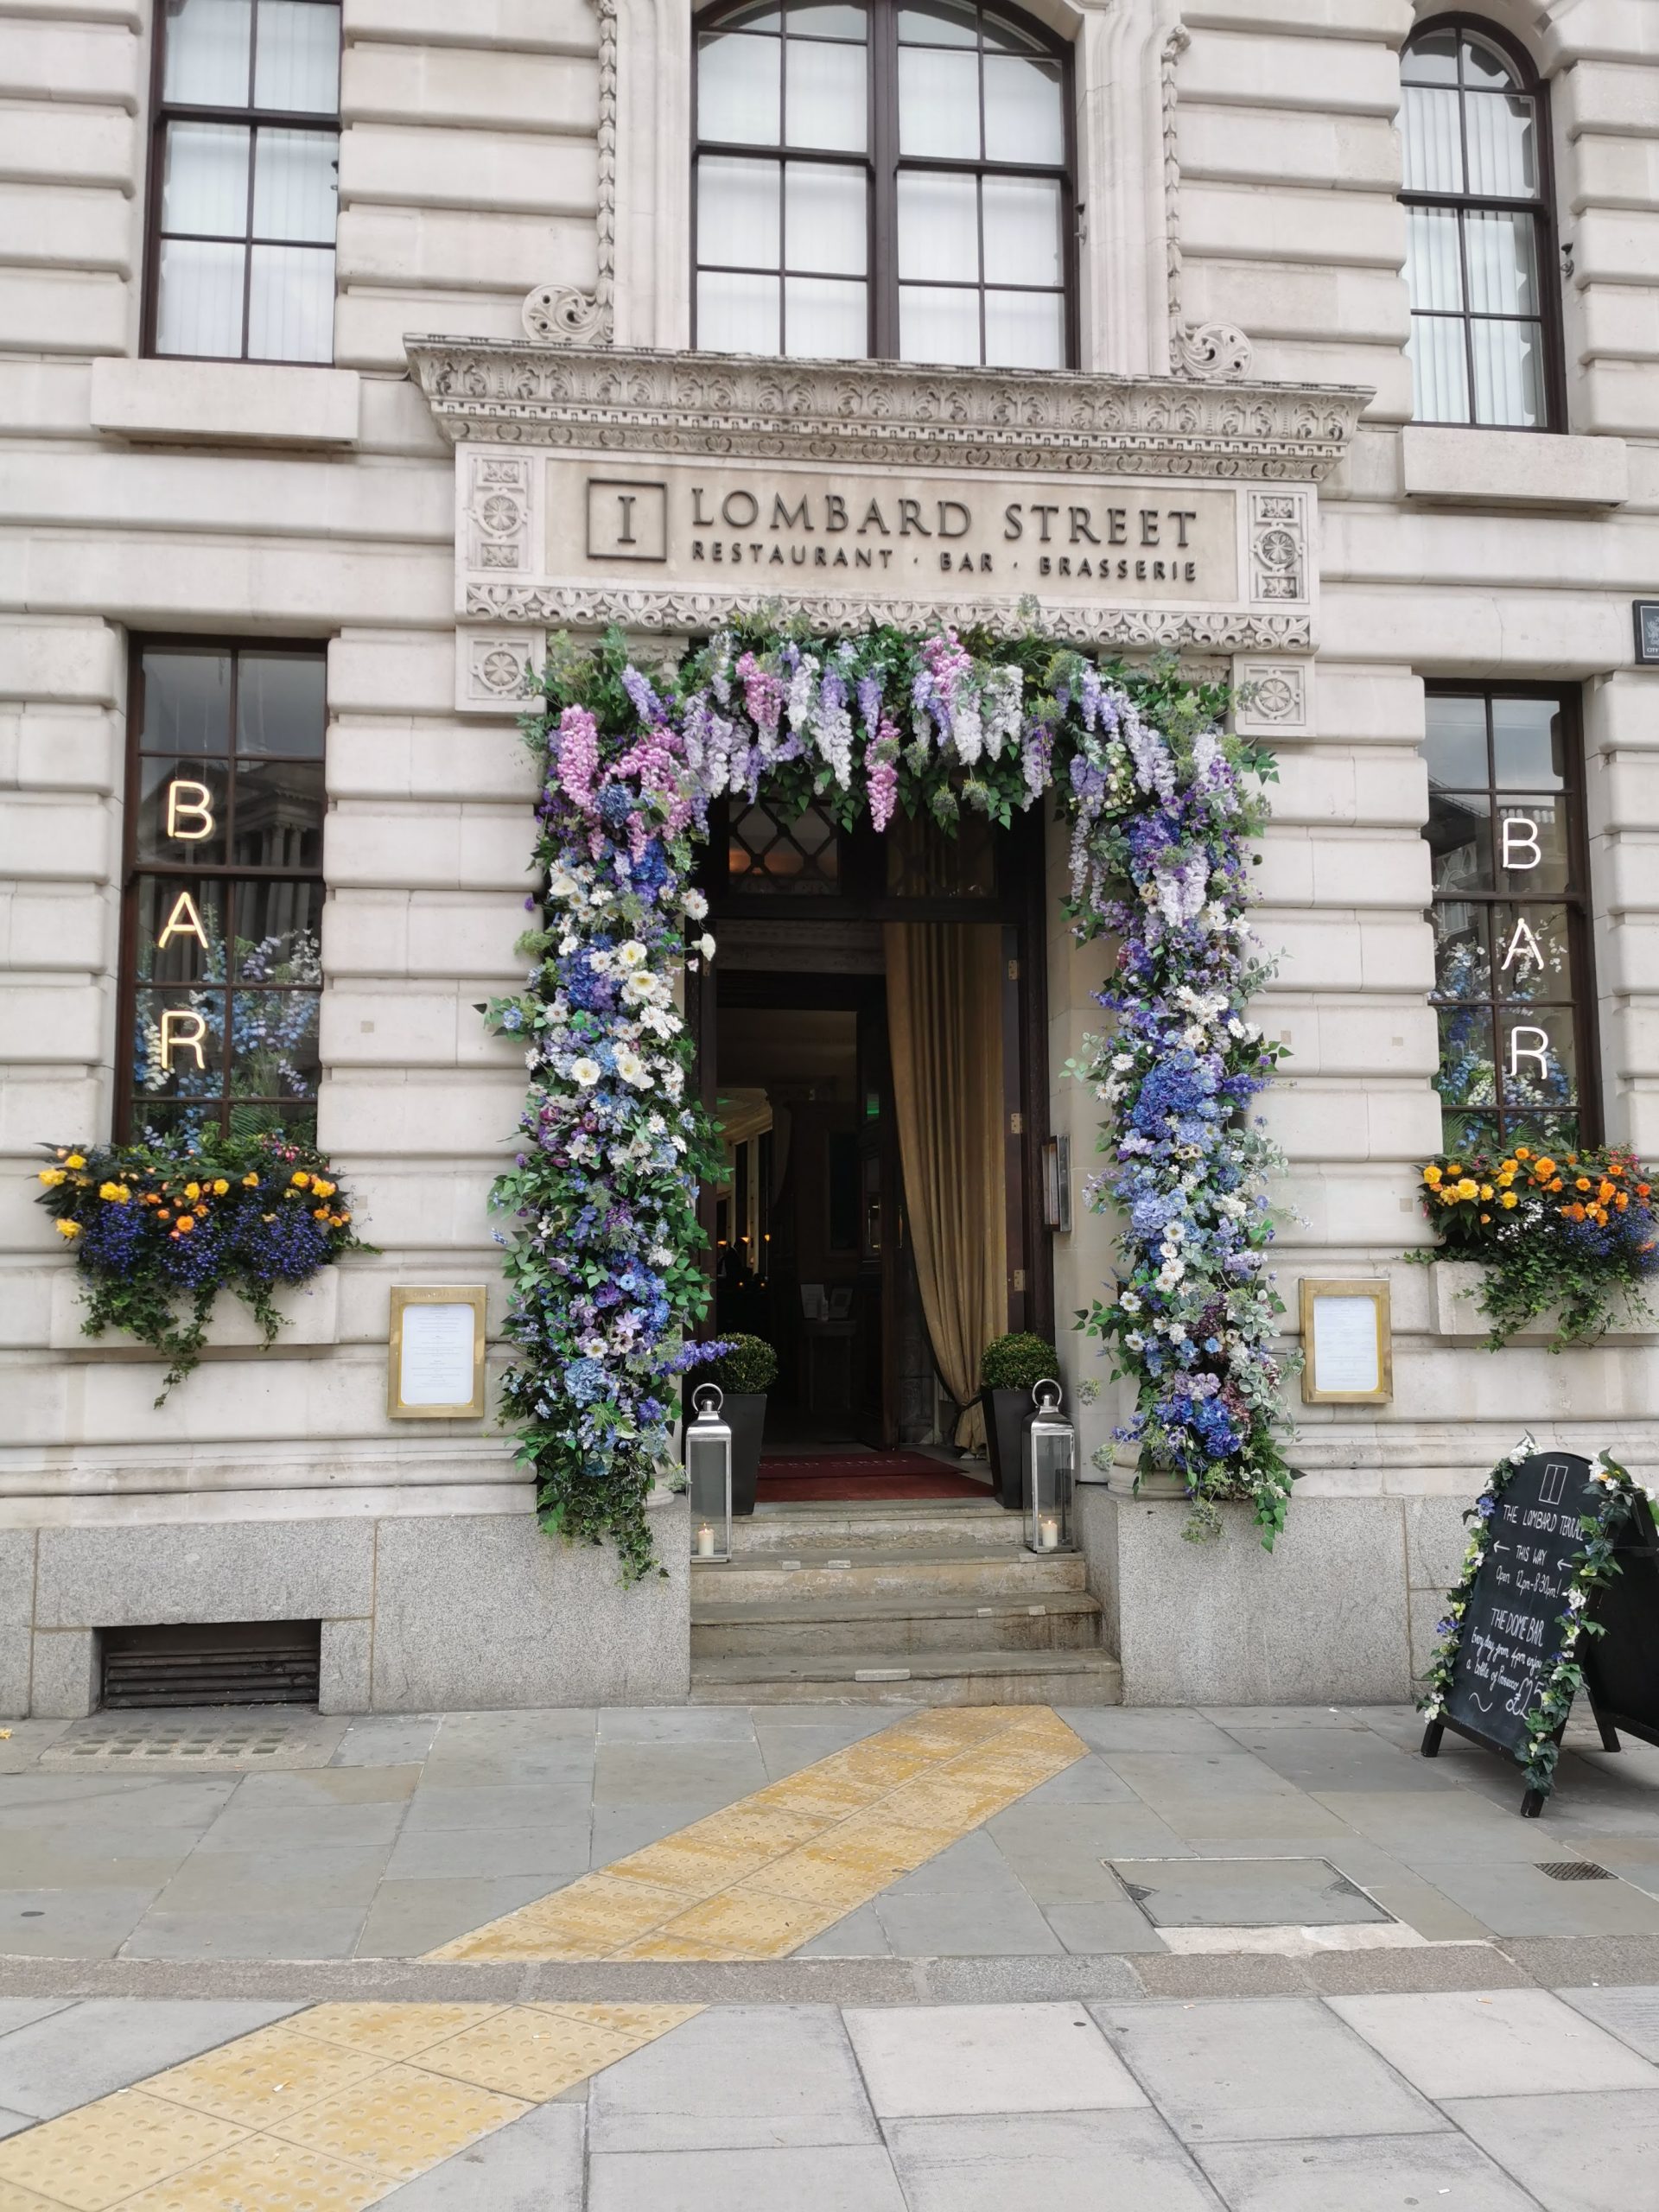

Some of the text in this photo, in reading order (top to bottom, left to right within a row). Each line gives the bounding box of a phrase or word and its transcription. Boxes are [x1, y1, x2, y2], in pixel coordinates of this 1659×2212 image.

[691, 487, 1197, 547] LOMBARD STREET
[691, 540, 1196, 582] RESTAURANT BAR BRASSERIE
[158, 780, 216, 1070] BAR
[1501, 817, 1549, 1081] BAR
[1503, 1504, 1519, 1523] THE
[1522, 1510, 1557, 1532] LOMBARD
[1516, 1545, 1548, 1567] THIS WAY
[1496, 1565, 1510, 1586] Open
[1491, 1607, 1545, 1647] THE DOME BAR
[1466, 1657, 1520, 1692] a bottle of Prosecco
[1492, 1643, 1510, 1662] from
[1510, 1646, 1527, 1669] 4pm
